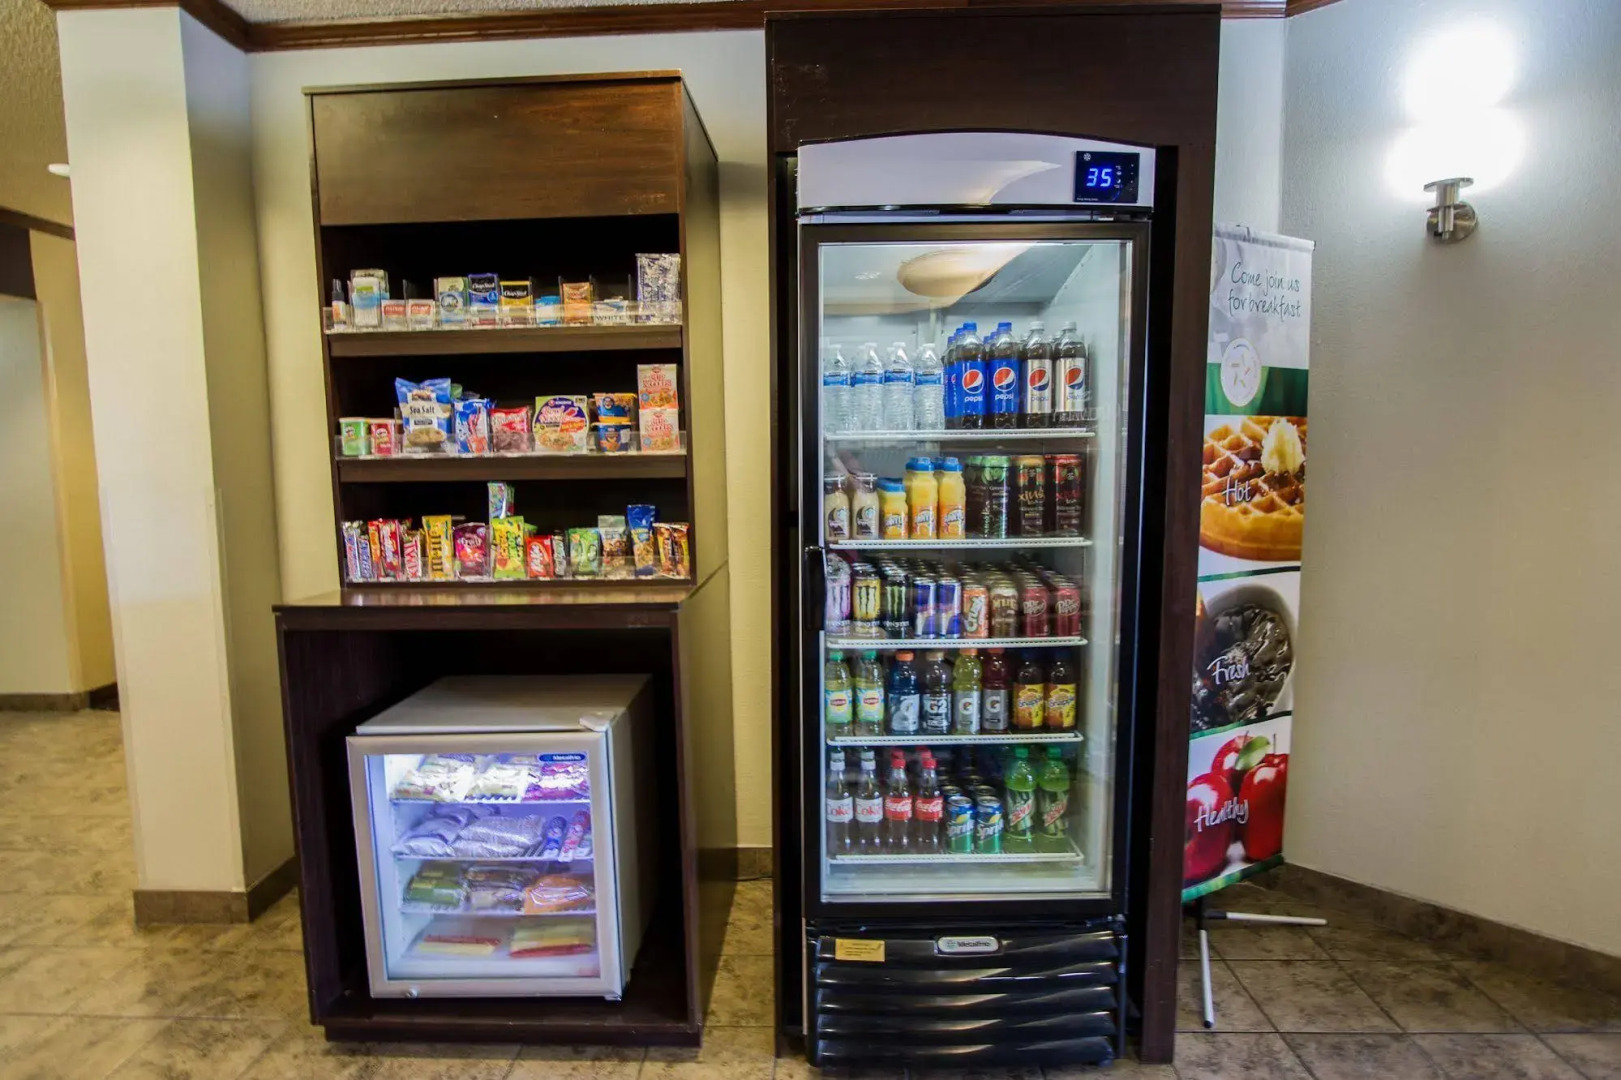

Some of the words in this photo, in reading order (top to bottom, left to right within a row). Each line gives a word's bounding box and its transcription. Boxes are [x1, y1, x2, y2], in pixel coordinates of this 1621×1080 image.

[1086, 168, 1112, 187] 35
[1231, 262, 1262, 286] Come
[1264, 269, 1285, 296] join
[1287, 278, 1300, 292] us
[1228, 289, 1246, 317] for
[1249, 295, 1302, 322] breakfast
[409, 405, 421, 414] Sea
[422, 405, 435, 414] Salt
[995, 392, 1014, 401] pepsi
[1222, 476, 1251, 506] Hot
[1207, 655, 1251, 684] Fresh
[930, 700, 947, 713] G2
[1194, 797, 1248, 832] Healthy
